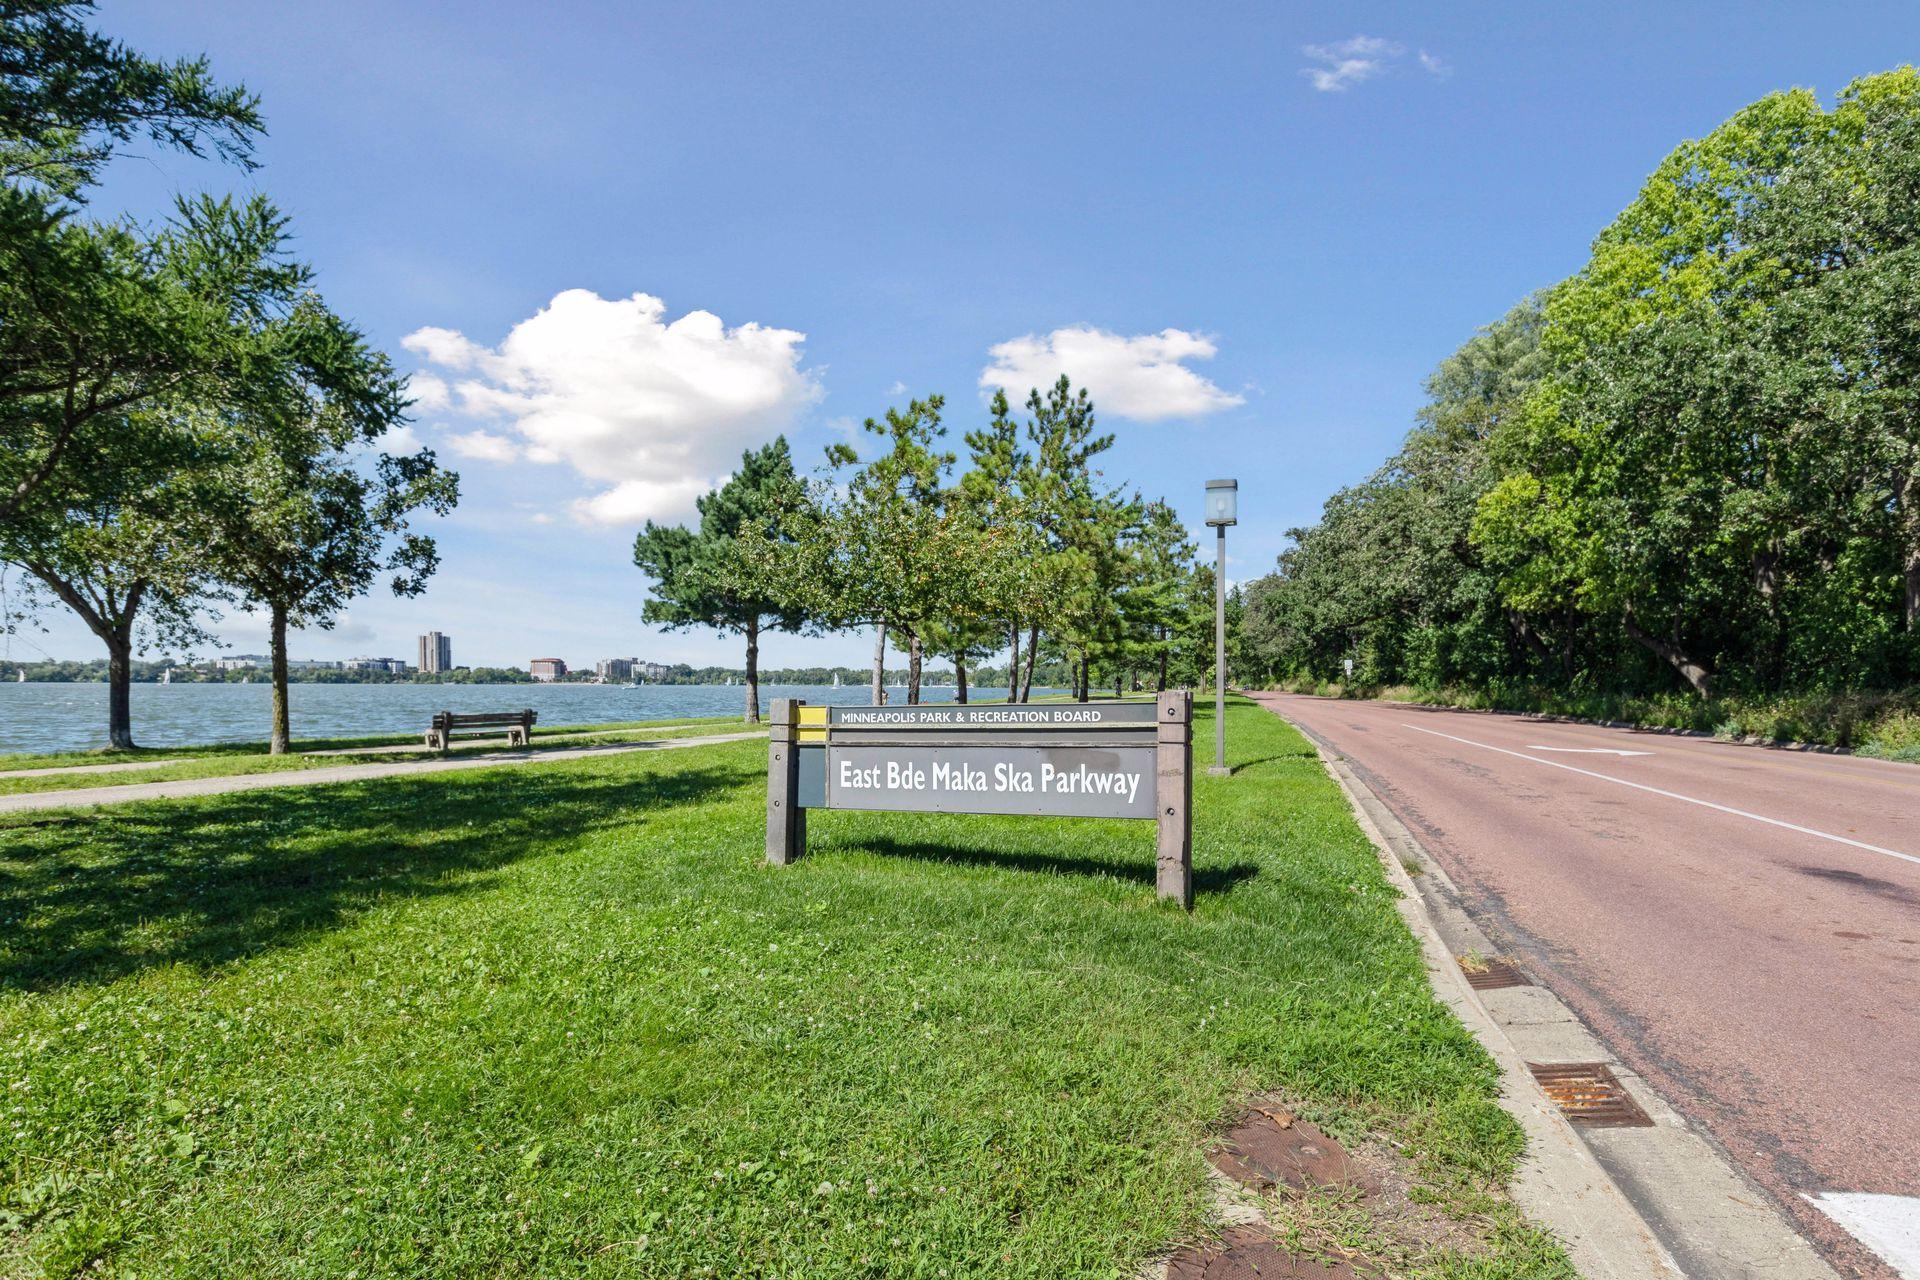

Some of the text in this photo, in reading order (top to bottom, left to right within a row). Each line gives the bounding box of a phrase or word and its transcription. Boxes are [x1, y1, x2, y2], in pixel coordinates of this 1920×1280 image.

[841, 710, 1101, 723] MINNEAPOLIS PARK & RECREATION BOARD
[840, 761, 1141, 804] East Bde Maka Ska Parkway
